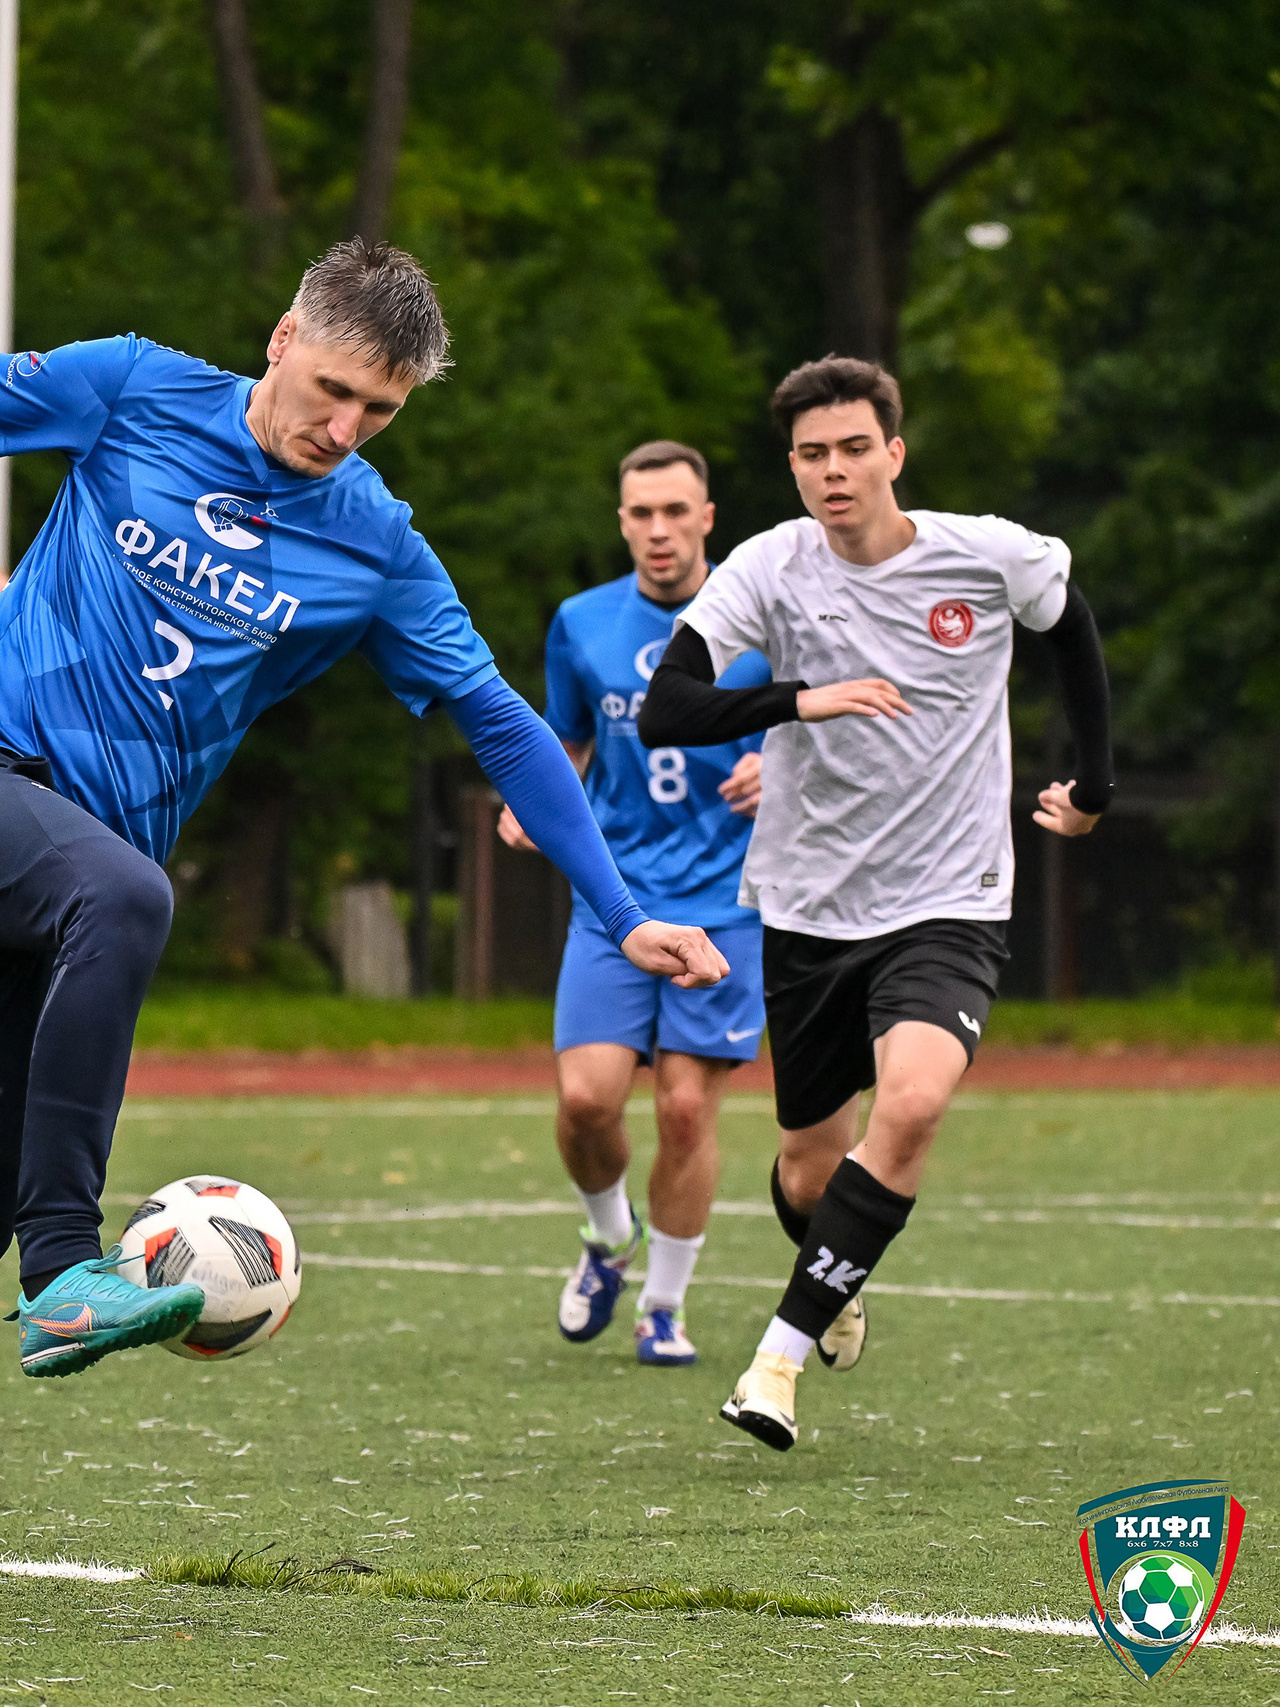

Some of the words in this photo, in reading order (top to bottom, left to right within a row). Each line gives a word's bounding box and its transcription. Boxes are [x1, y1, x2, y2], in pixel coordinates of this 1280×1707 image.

[115, 518, 301, 633] ФАКЕЛ
[152, 577, 252, 631] КОНСТРУКТОРСКОЕ
[250, 626, 278, 644] БЮРО
[170, 599, 213, 624] СТРУКТУРА
[213, 620, 230, 632] НПО
[647, 746, 689, 804] 8
